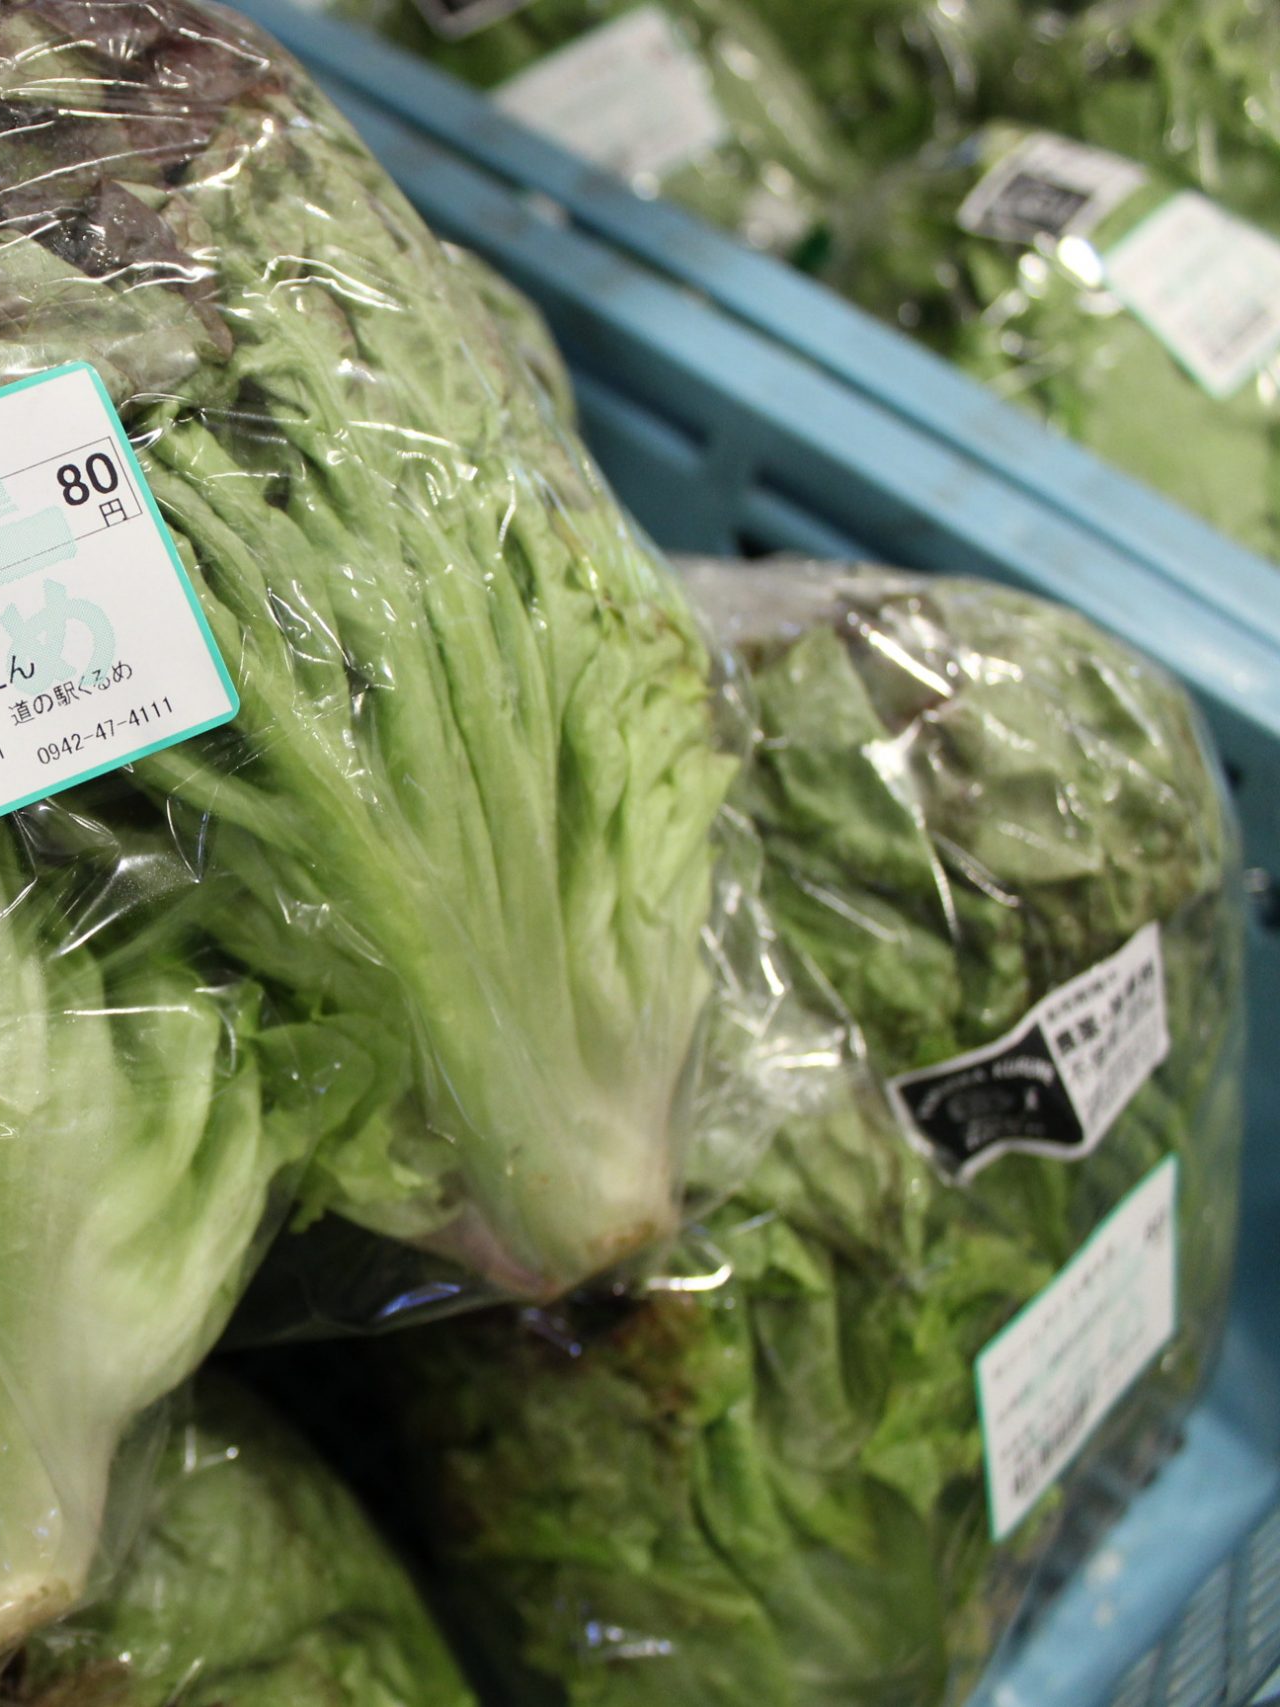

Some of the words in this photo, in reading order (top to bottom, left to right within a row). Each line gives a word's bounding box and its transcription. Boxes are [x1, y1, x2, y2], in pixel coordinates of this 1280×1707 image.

[57, 453, 118, 506] 80
[99, 498, 128, 527] 円
[9, 661, 133, 726] 道の駅くるめ
[37, 697, 173, 764] 0942-47-4111
